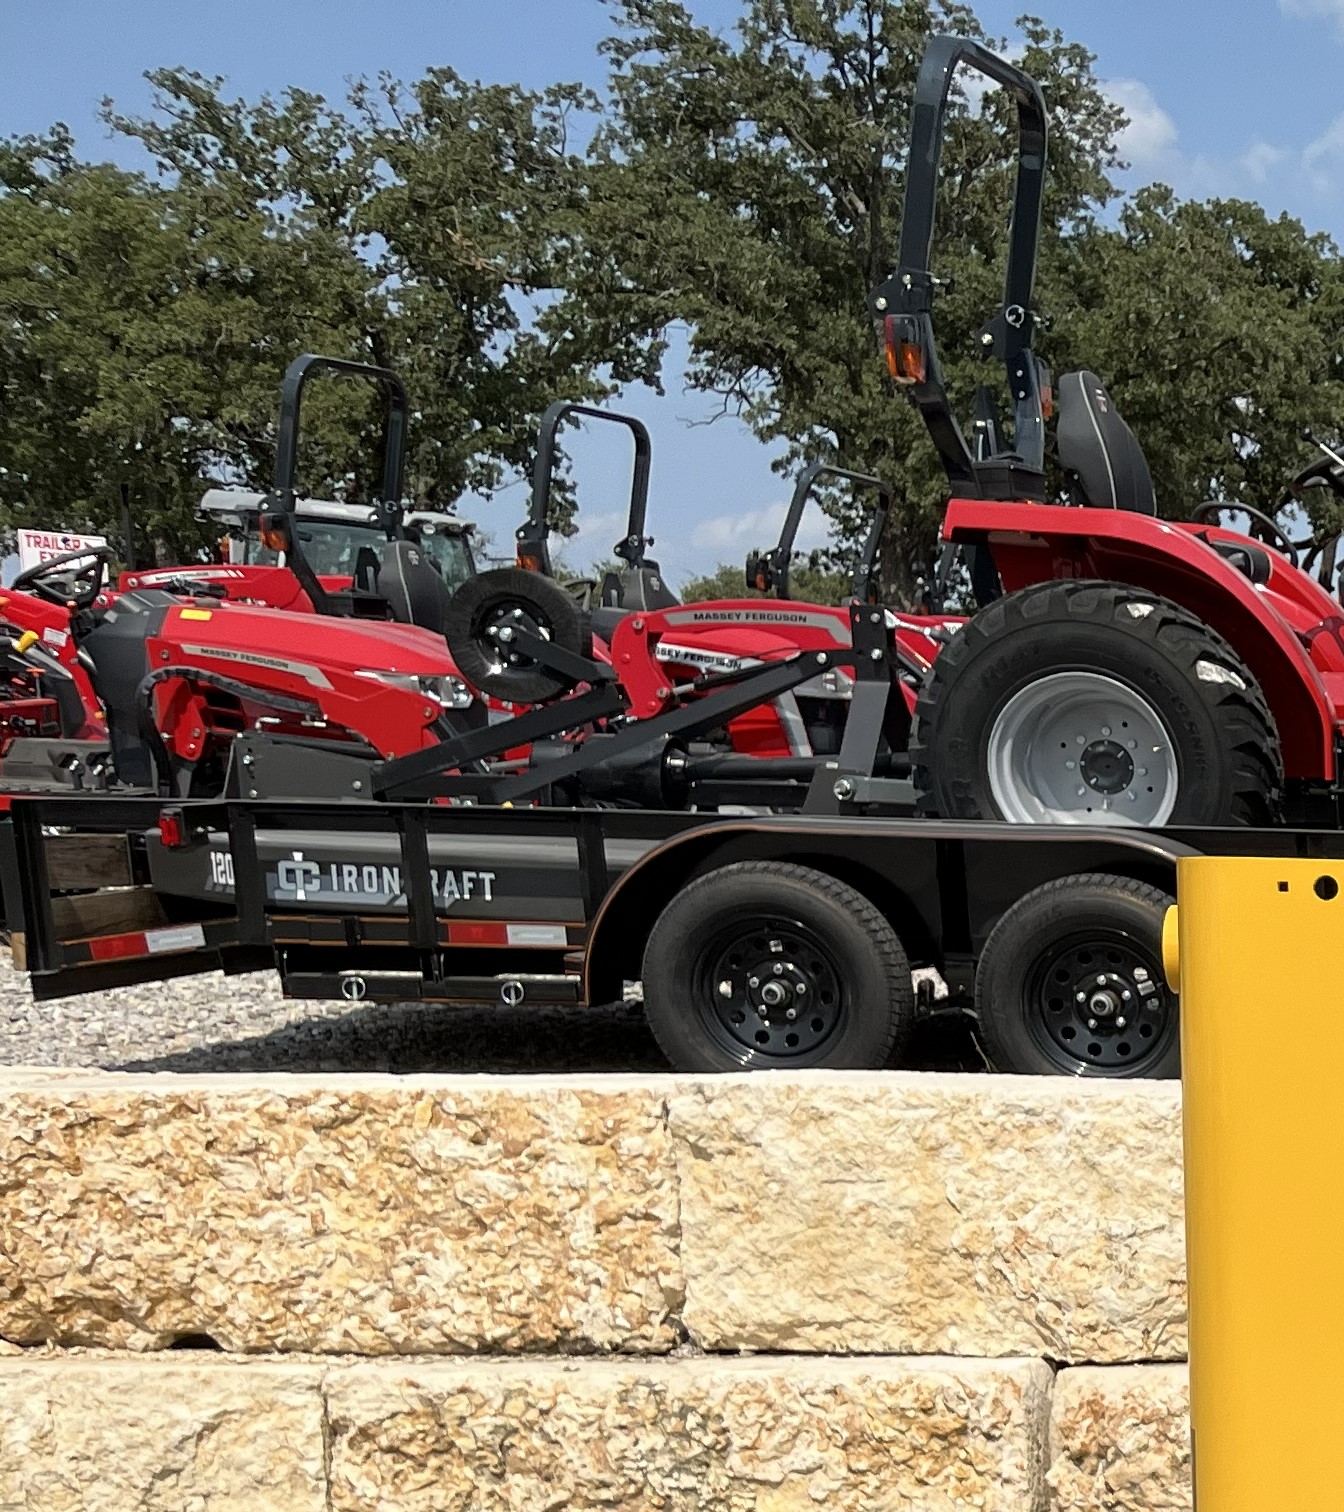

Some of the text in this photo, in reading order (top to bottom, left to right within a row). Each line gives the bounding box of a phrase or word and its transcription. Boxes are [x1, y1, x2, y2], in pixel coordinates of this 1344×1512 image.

[693, 612, 807, 623] MASSEY FERGUSON
[200, 648, 289, 669] MASSEY FERGUSON
